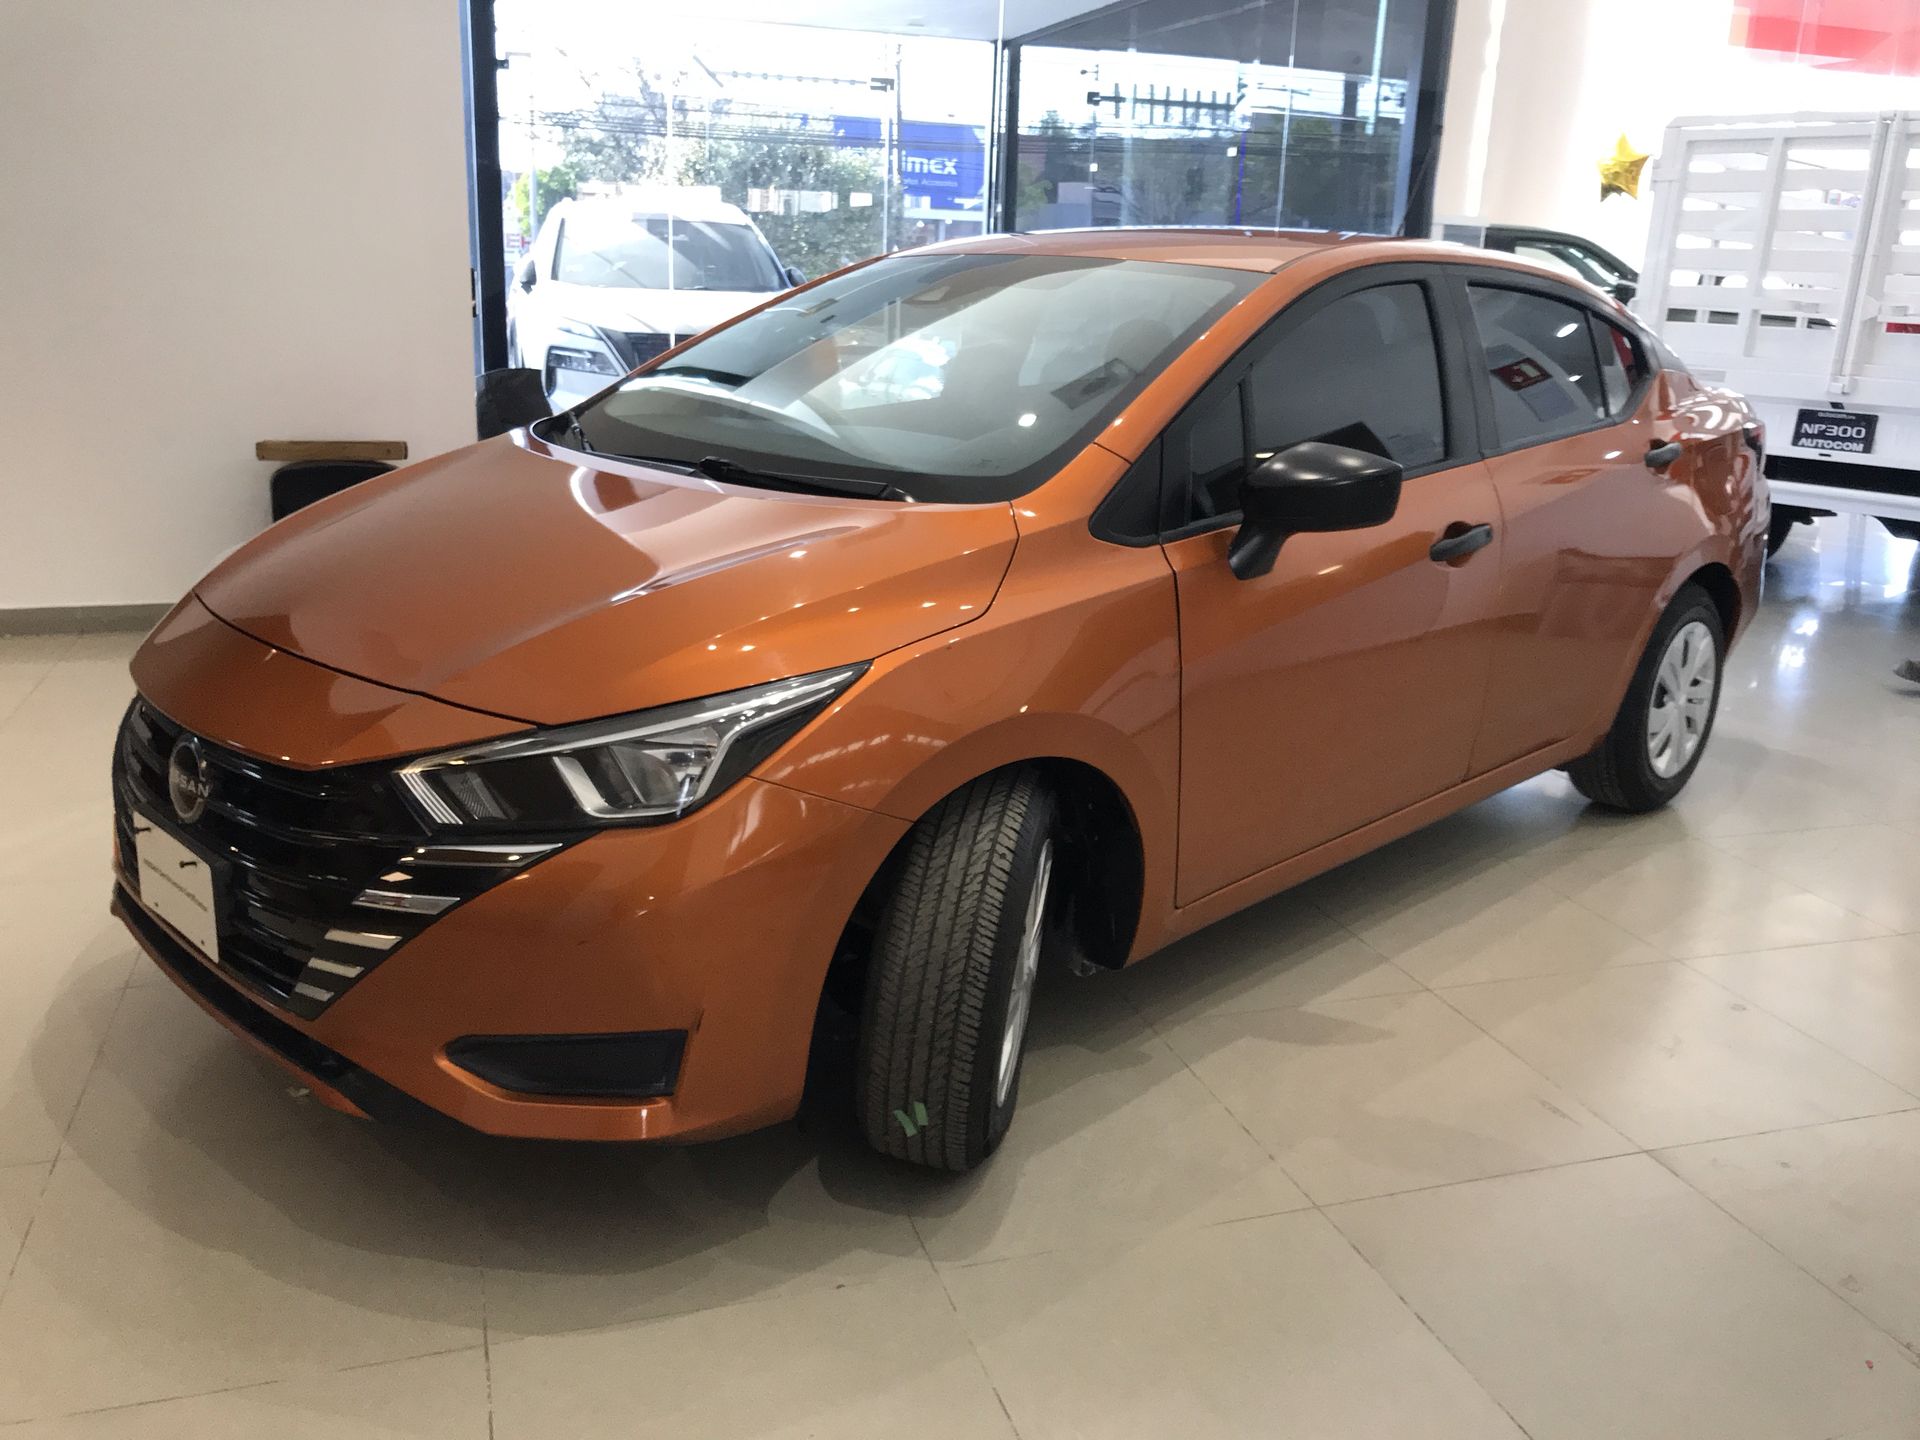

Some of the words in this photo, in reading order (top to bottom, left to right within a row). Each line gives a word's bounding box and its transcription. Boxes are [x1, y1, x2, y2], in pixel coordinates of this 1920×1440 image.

[890, 149, 960, 176] imex
[1800, 422, 1866, 439] NP300
[1797, 437, 1864, 453] AUTOCOM
